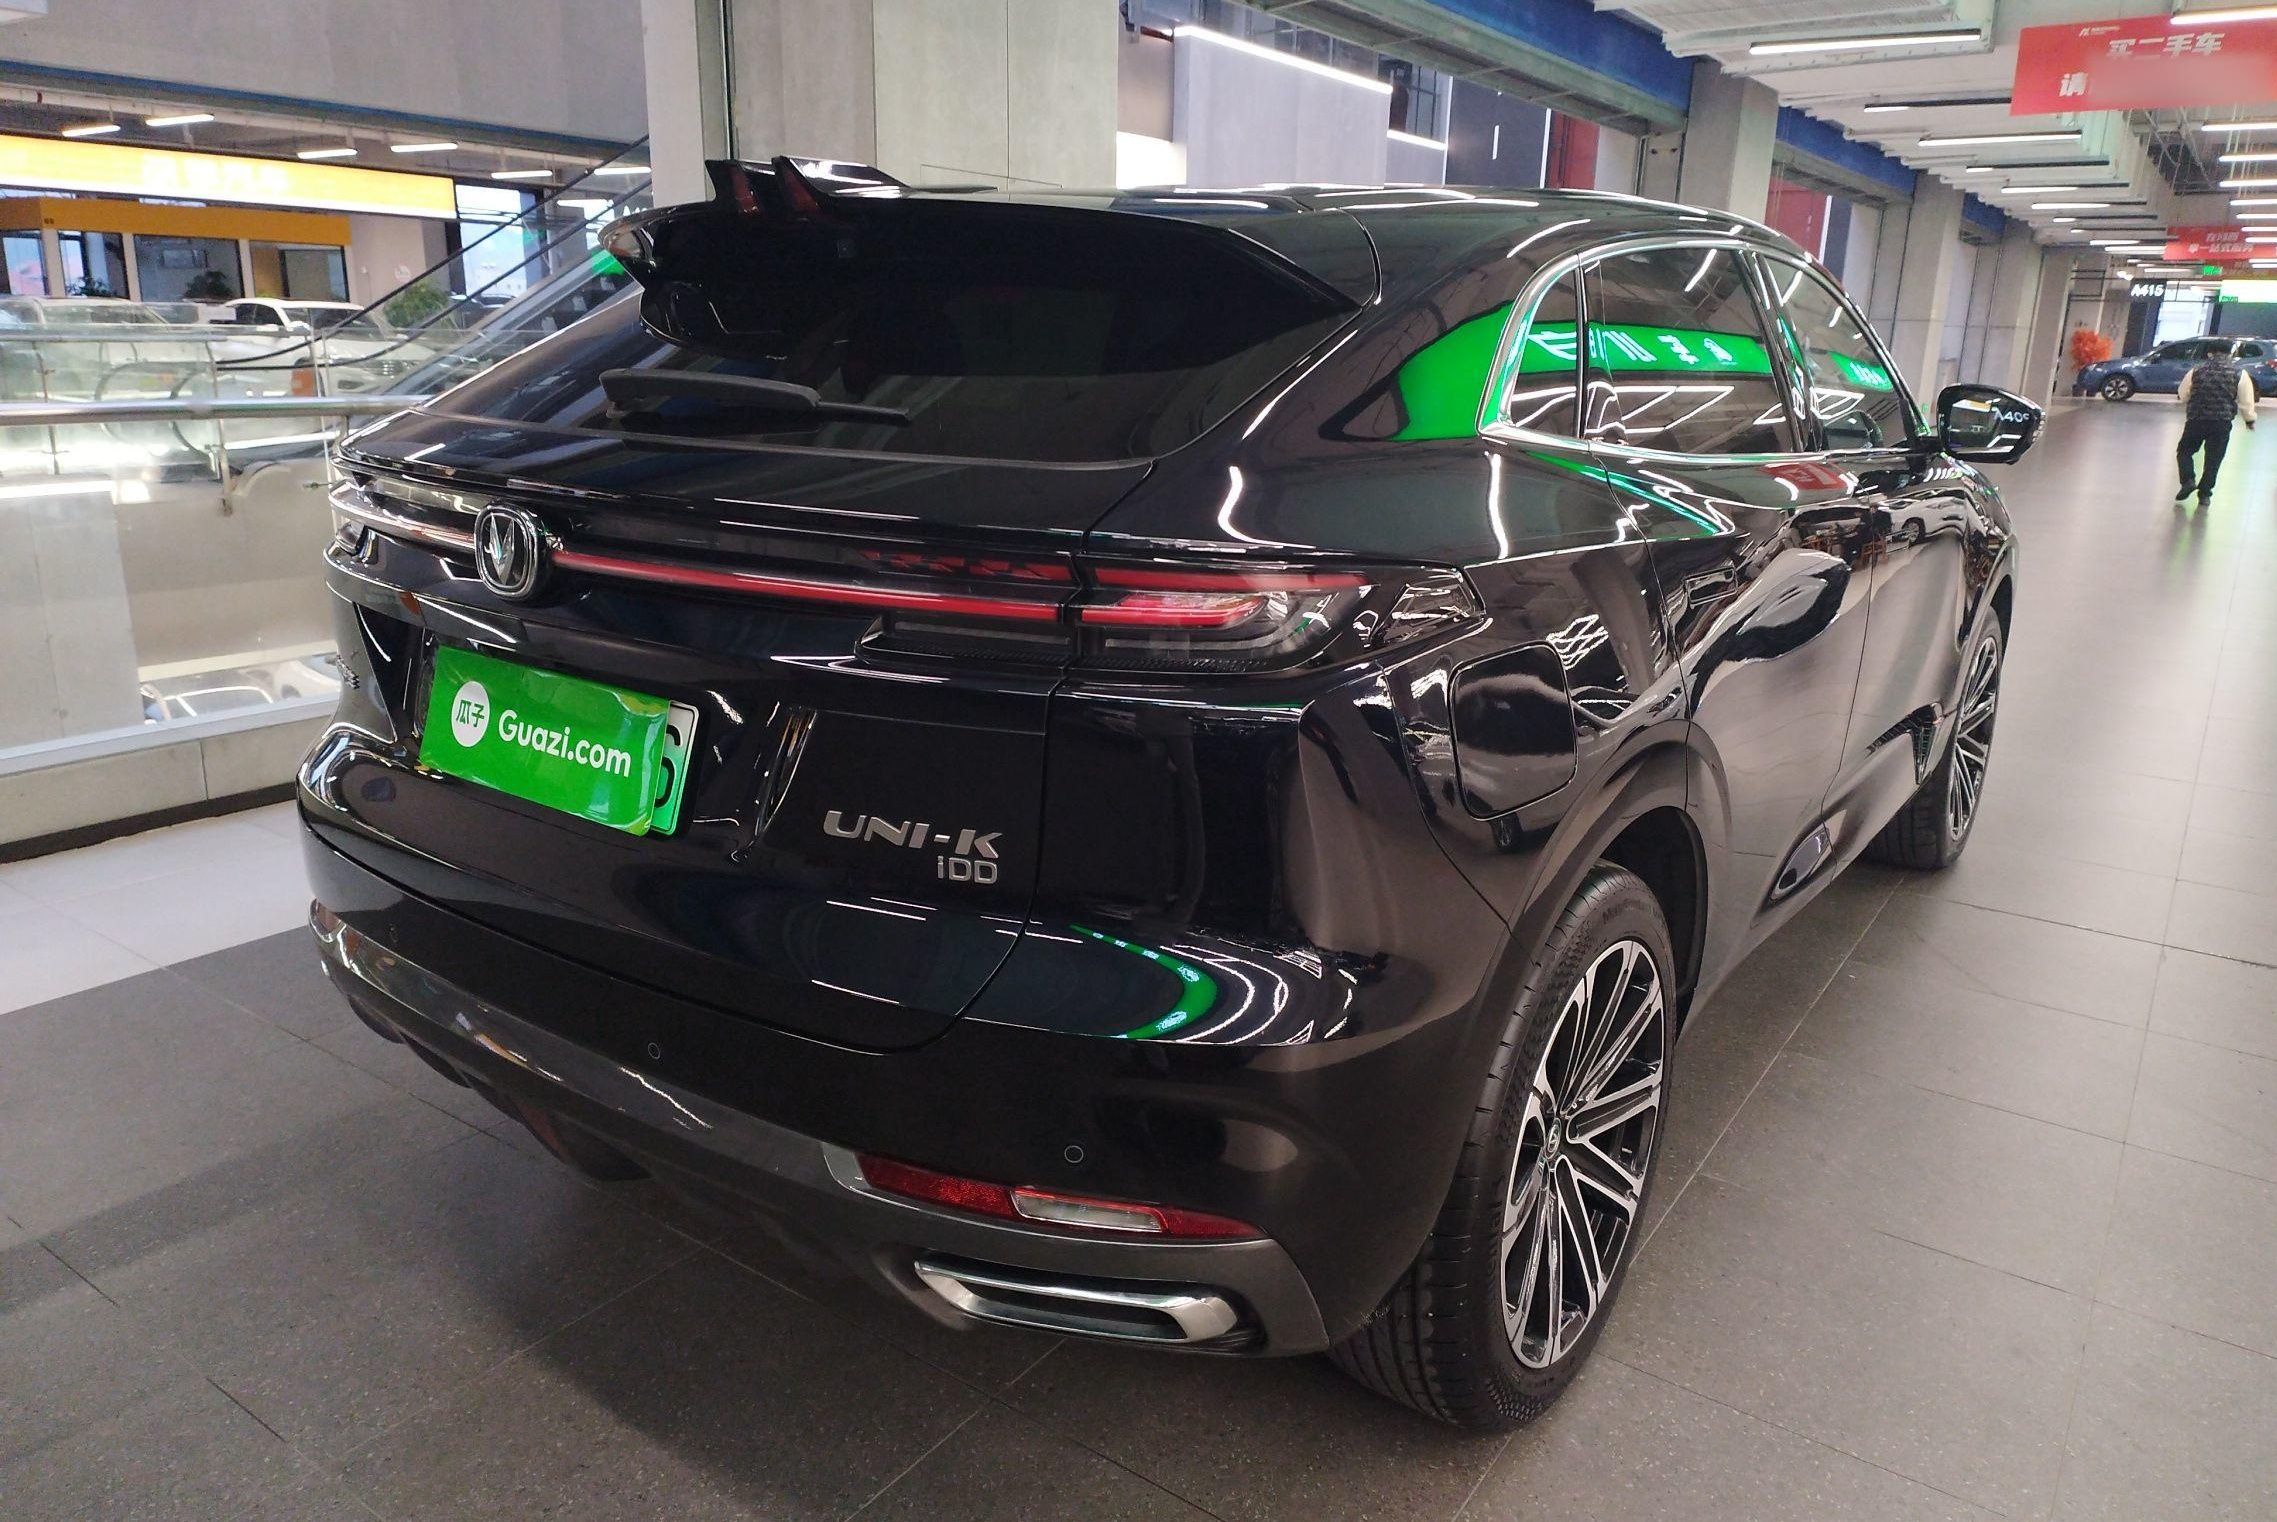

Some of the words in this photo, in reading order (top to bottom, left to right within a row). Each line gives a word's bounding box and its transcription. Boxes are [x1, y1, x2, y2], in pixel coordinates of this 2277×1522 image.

[455, 698, 486, 728] 瓜子
[498, 709, 632, 778] Guazi.com
[823, 810, 1002, 859] UNI-K
[937, 855, 998, 884] iDD
